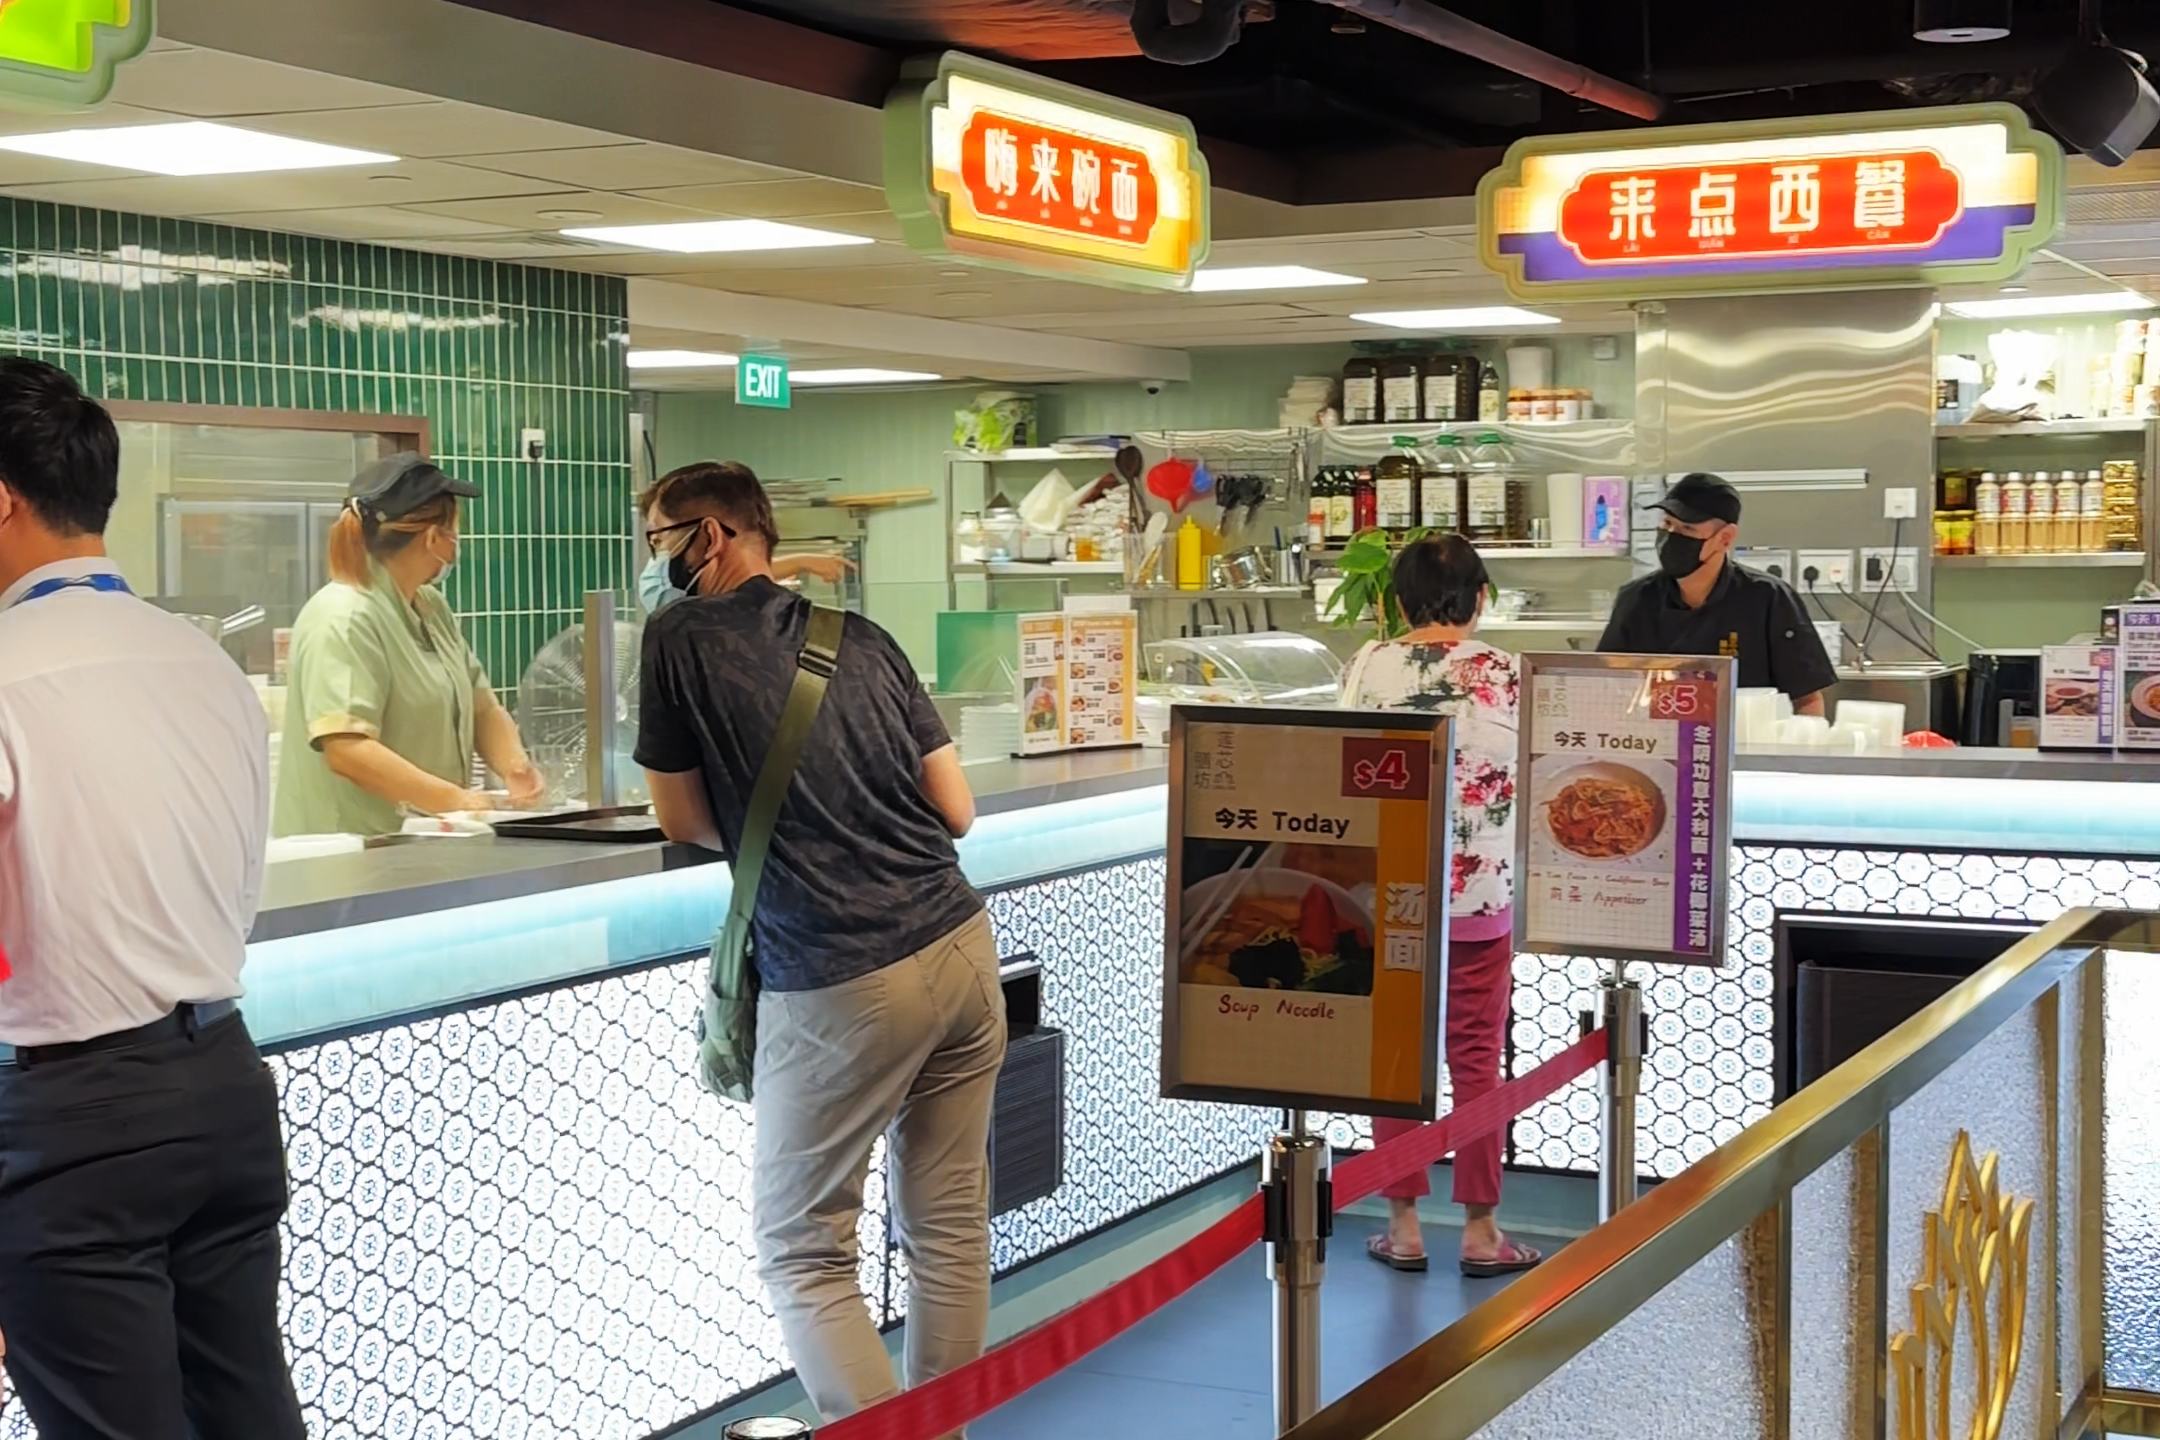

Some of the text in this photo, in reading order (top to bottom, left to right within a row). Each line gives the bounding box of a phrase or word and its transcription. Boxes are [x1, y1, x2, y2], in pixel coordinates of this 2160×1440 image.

[985, 128, 1138, 221] 嗨来碗面
[1608, 160, 1905, 240] 来点西餐
[745, 362, 783, 399] EXIT
[1657, 685, 1699, 715] $5
[1554, 731, 1657, 753] 今天 Today
[1352, 750, 1410, 790] $4
[1214, 808, 1350, 839] 今天 Today
[1383, 882, 1425, 973] 汤面
[1218, 994, 1336, 1021] Soup Noodle
